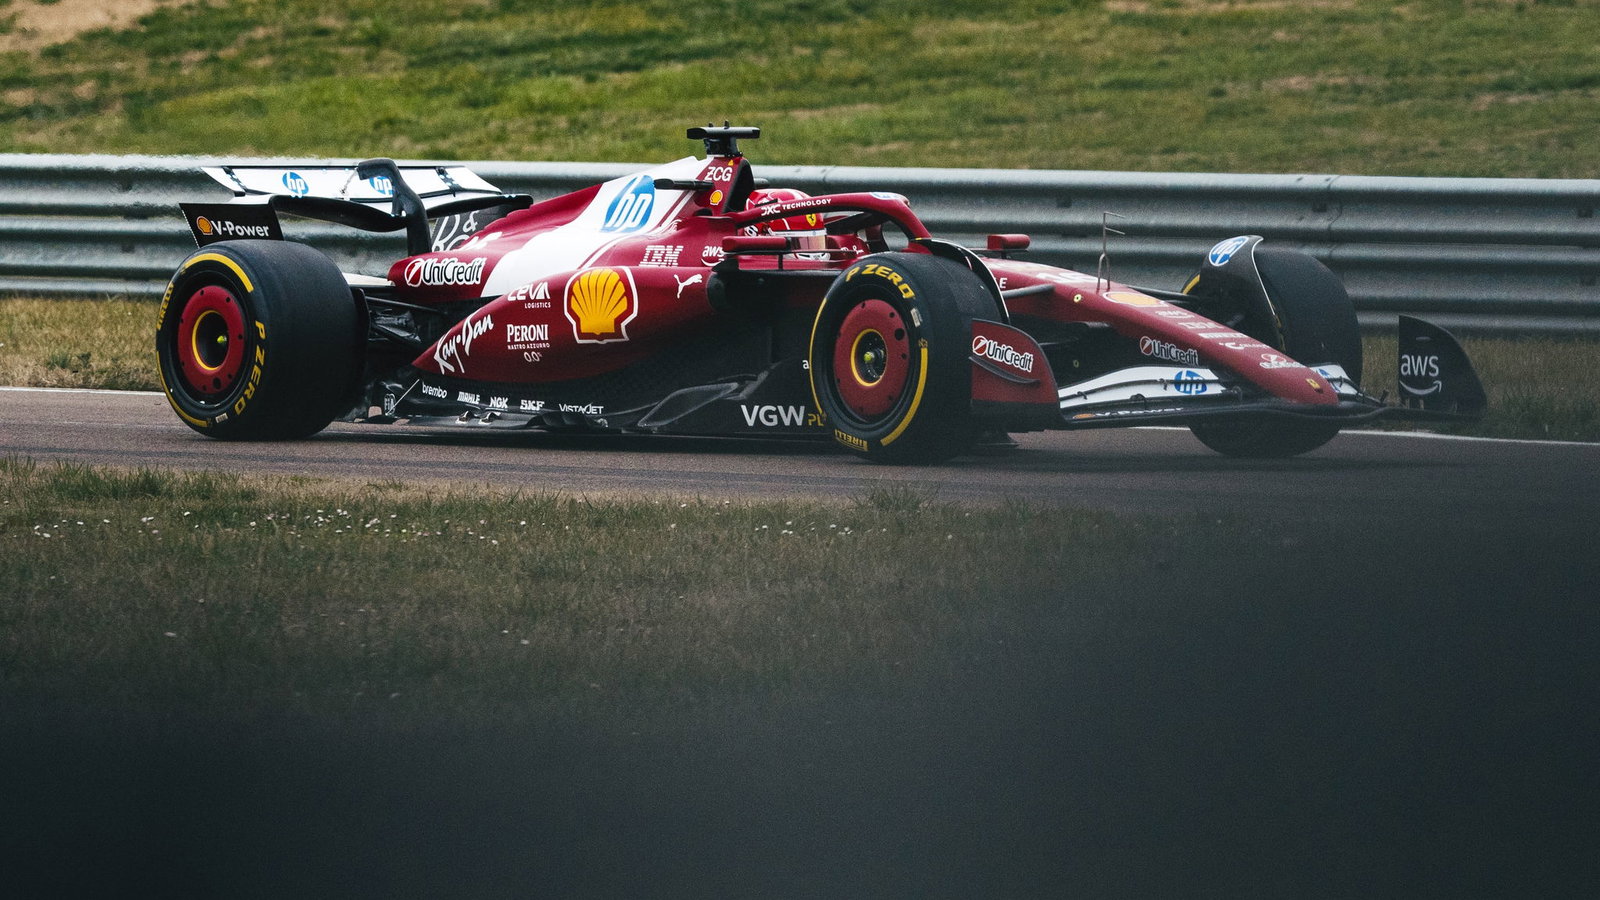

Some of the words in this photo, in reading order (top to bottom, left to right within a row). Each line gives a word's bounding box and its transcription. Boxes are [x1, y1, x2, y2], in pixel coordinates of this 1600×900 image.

[284, 172, 308, 197] hp
[704, 166, 732, 181] ZCG
[600, 175, 655, 232] hp
[761, 204, 781, 216] DXC
[782, 199, 832, 210] TECHNOLOGY
[211, 221, 269, 237] V-Power
[639, 245, 684, 267] IBM
[422, 257, 486, 286] UniCredit
[845, 266, 860, 282] P
[861, 264, 917, 299] ZERO
[255, 320, 266, 340] P
[507, 324, 549, 342] PERONI
[986, 340, 1034, 372] UniCredit
[1152, 338, 1200, 366] UniCredit
[1401, 354, 1440, 376] aws
[234, 345, 266, 415] ZERO
[422, 382, 448, 399] brembo
[457, 391, 481, 405] MAHLE
[489, 396, 509, 409] NGK
[520, 399, 545, 410] SKF
[741, 404, 806, 427] VGW
